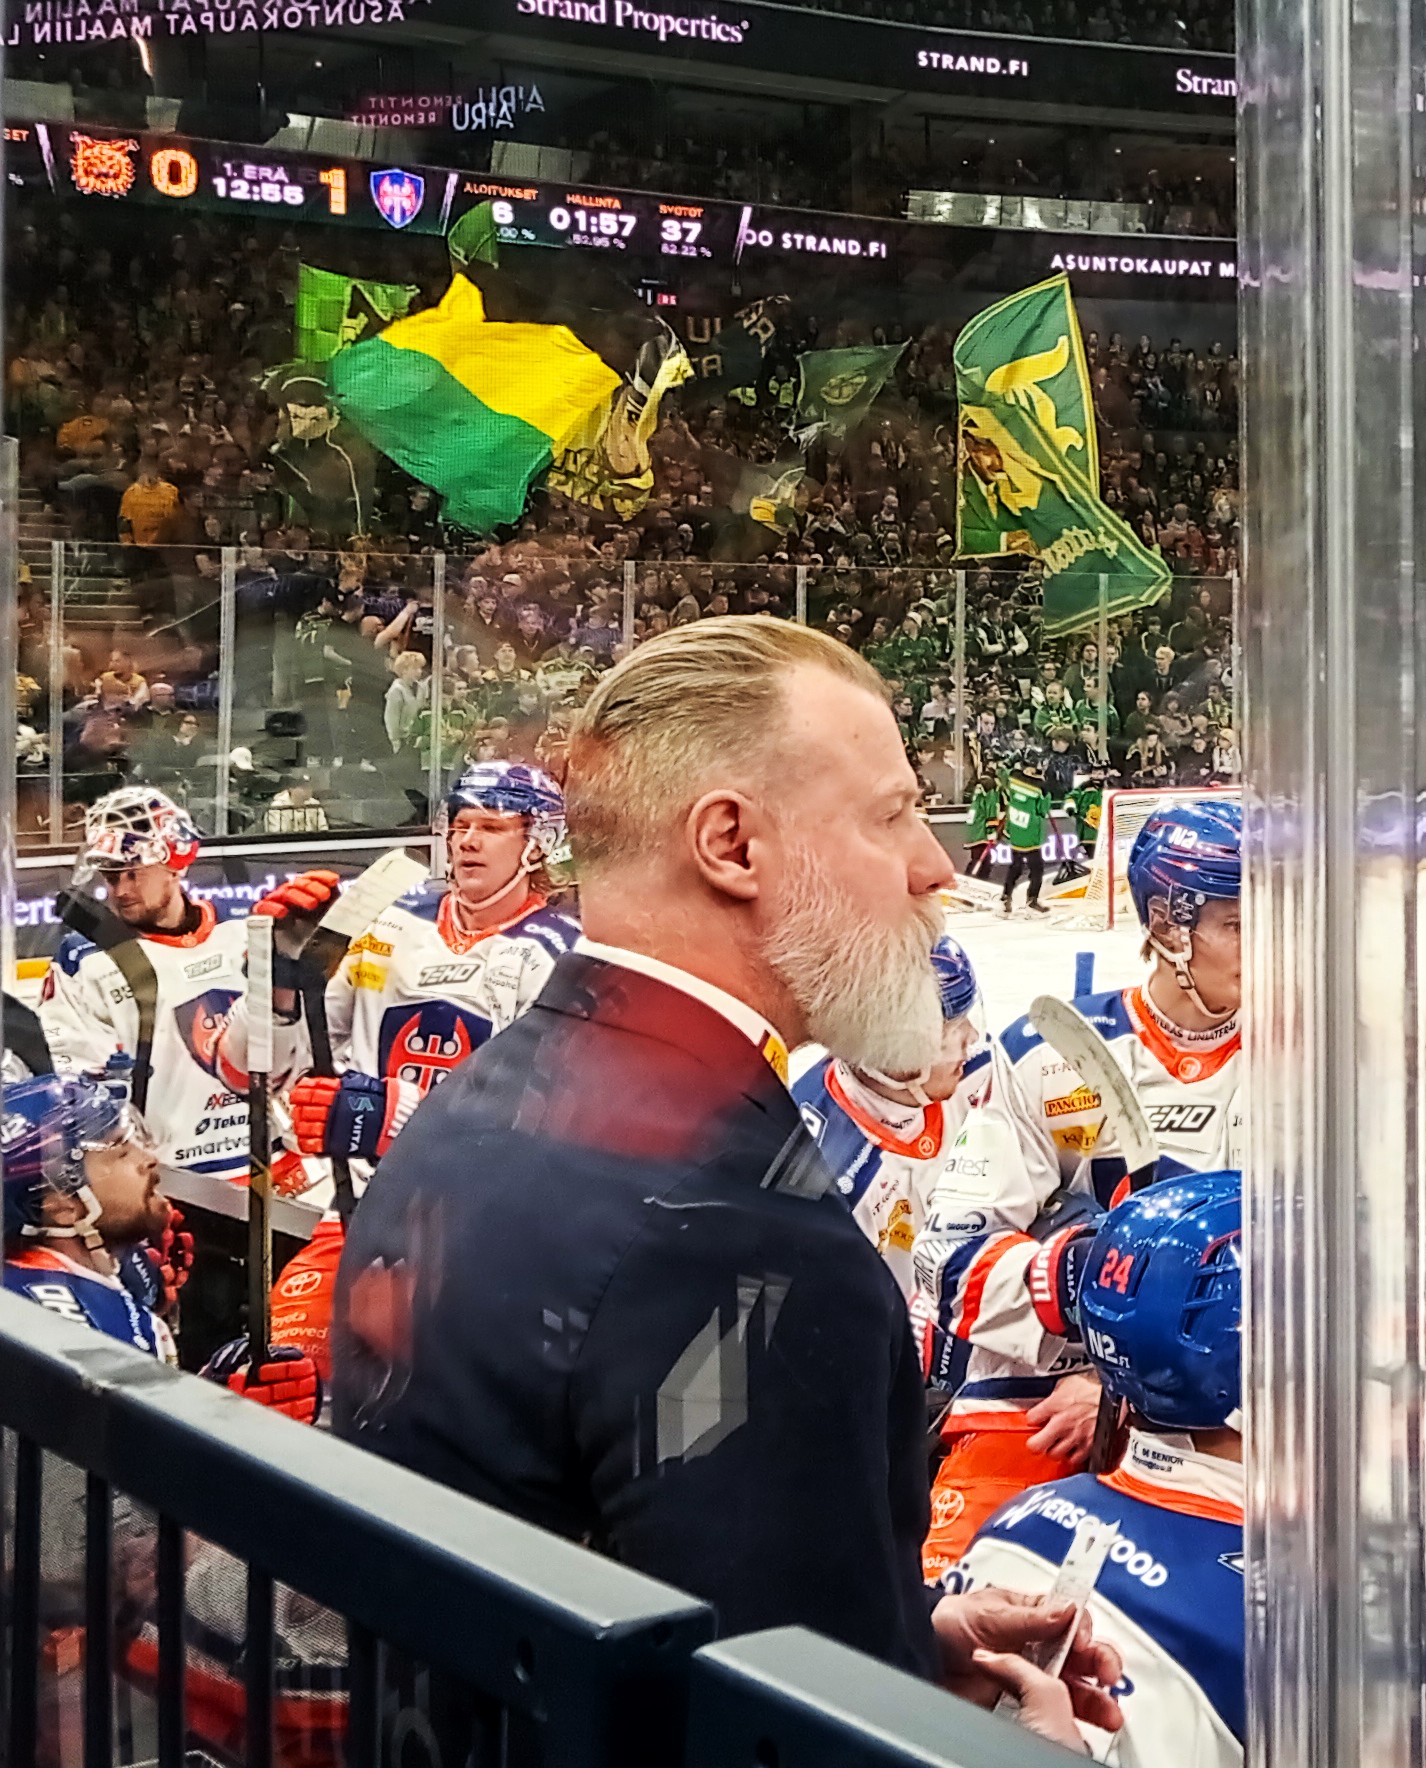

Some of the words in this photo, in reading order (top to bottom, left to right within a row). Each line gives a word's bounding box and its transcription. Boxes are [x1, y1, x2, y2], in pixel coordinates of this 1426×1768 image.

[917, 51, 1029, 77] STRAND.FI
[1176, 69, 1237, 97] Stran
[150, 149, 198, 198] 0
[319, 167, 347, 215] 1
[464, 181, 539, 201] ALOITUKSET
[565, 192, 623, 210] HALLINTA
[549, 206, 637, 237] 01:57
[660, 219, 702, 244] 37
[782, 233, 888, 259] STRAND.FI
[1050, 253, 1213, 277] ASUNTOKAUPAT
[1098, 1247, 1135, 1295] 24
